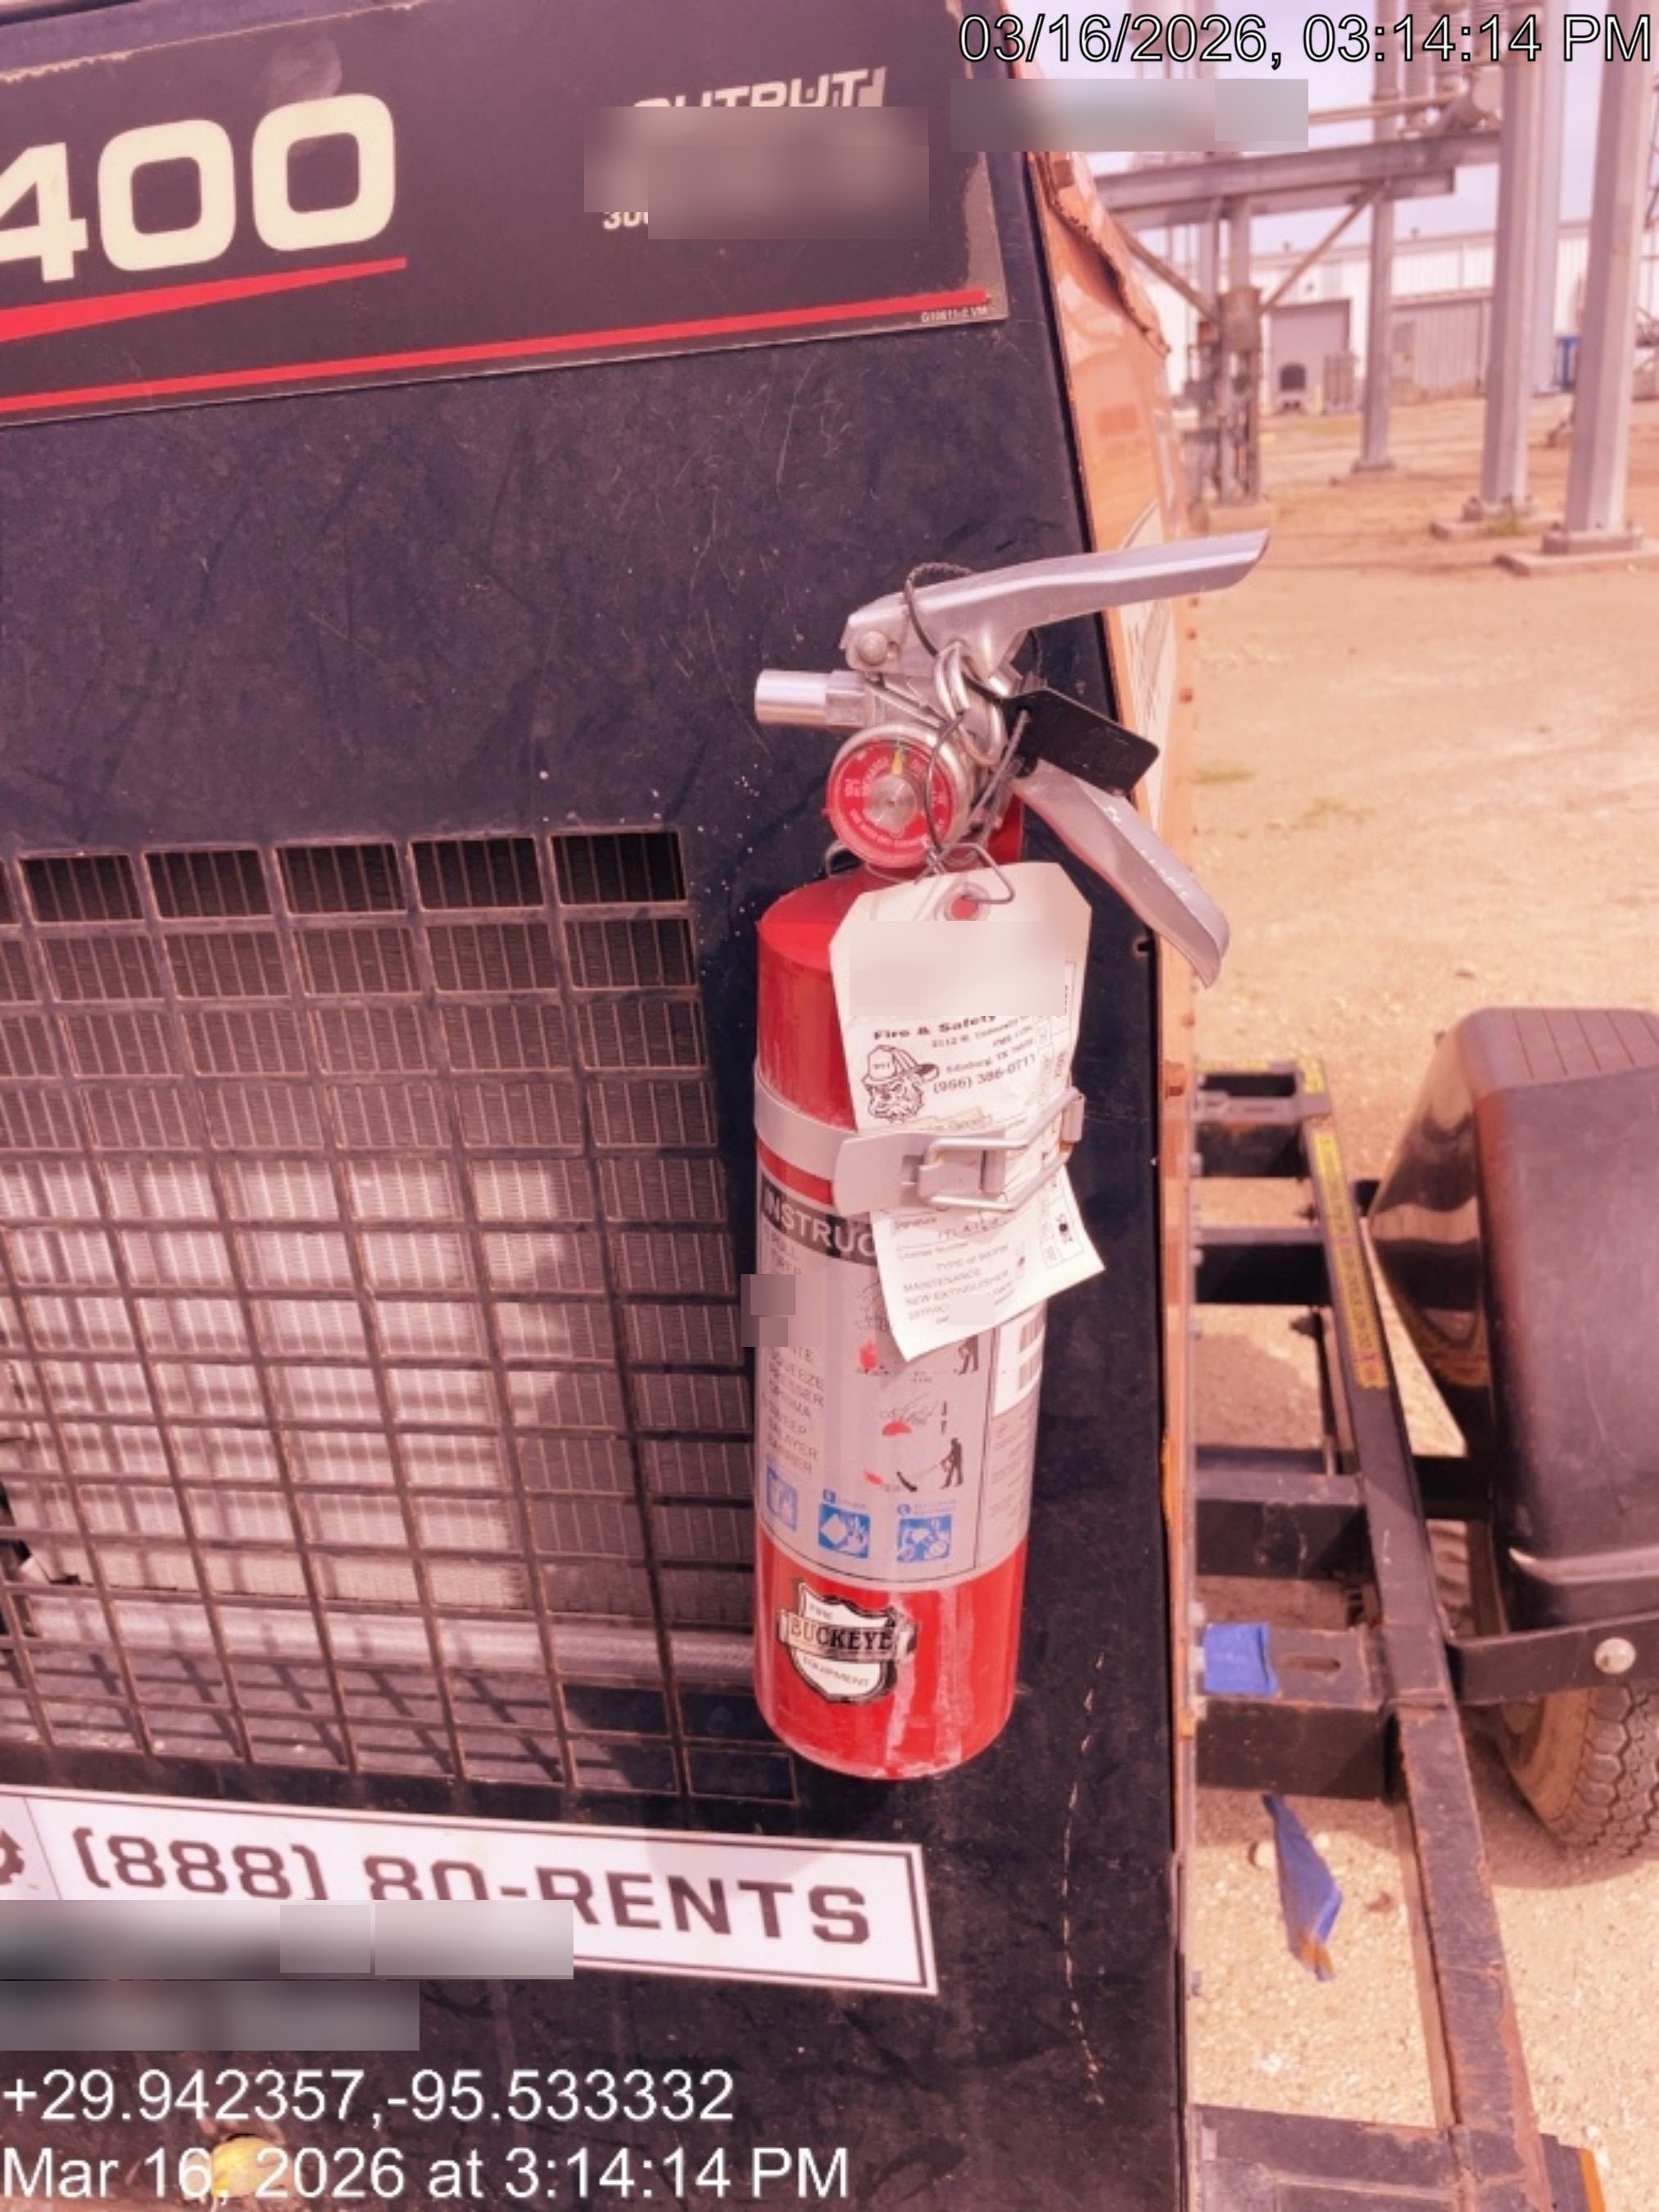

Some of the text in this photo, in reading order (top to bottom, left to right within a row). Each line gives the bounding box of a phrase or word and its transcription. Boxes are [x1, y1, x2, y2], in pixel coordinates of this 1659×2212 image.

[938, 1016, 997, 1033] Safety
[790, 1617, 893, 1650] BUCKEYE
[72, 1826, 329, 1901] (888)
